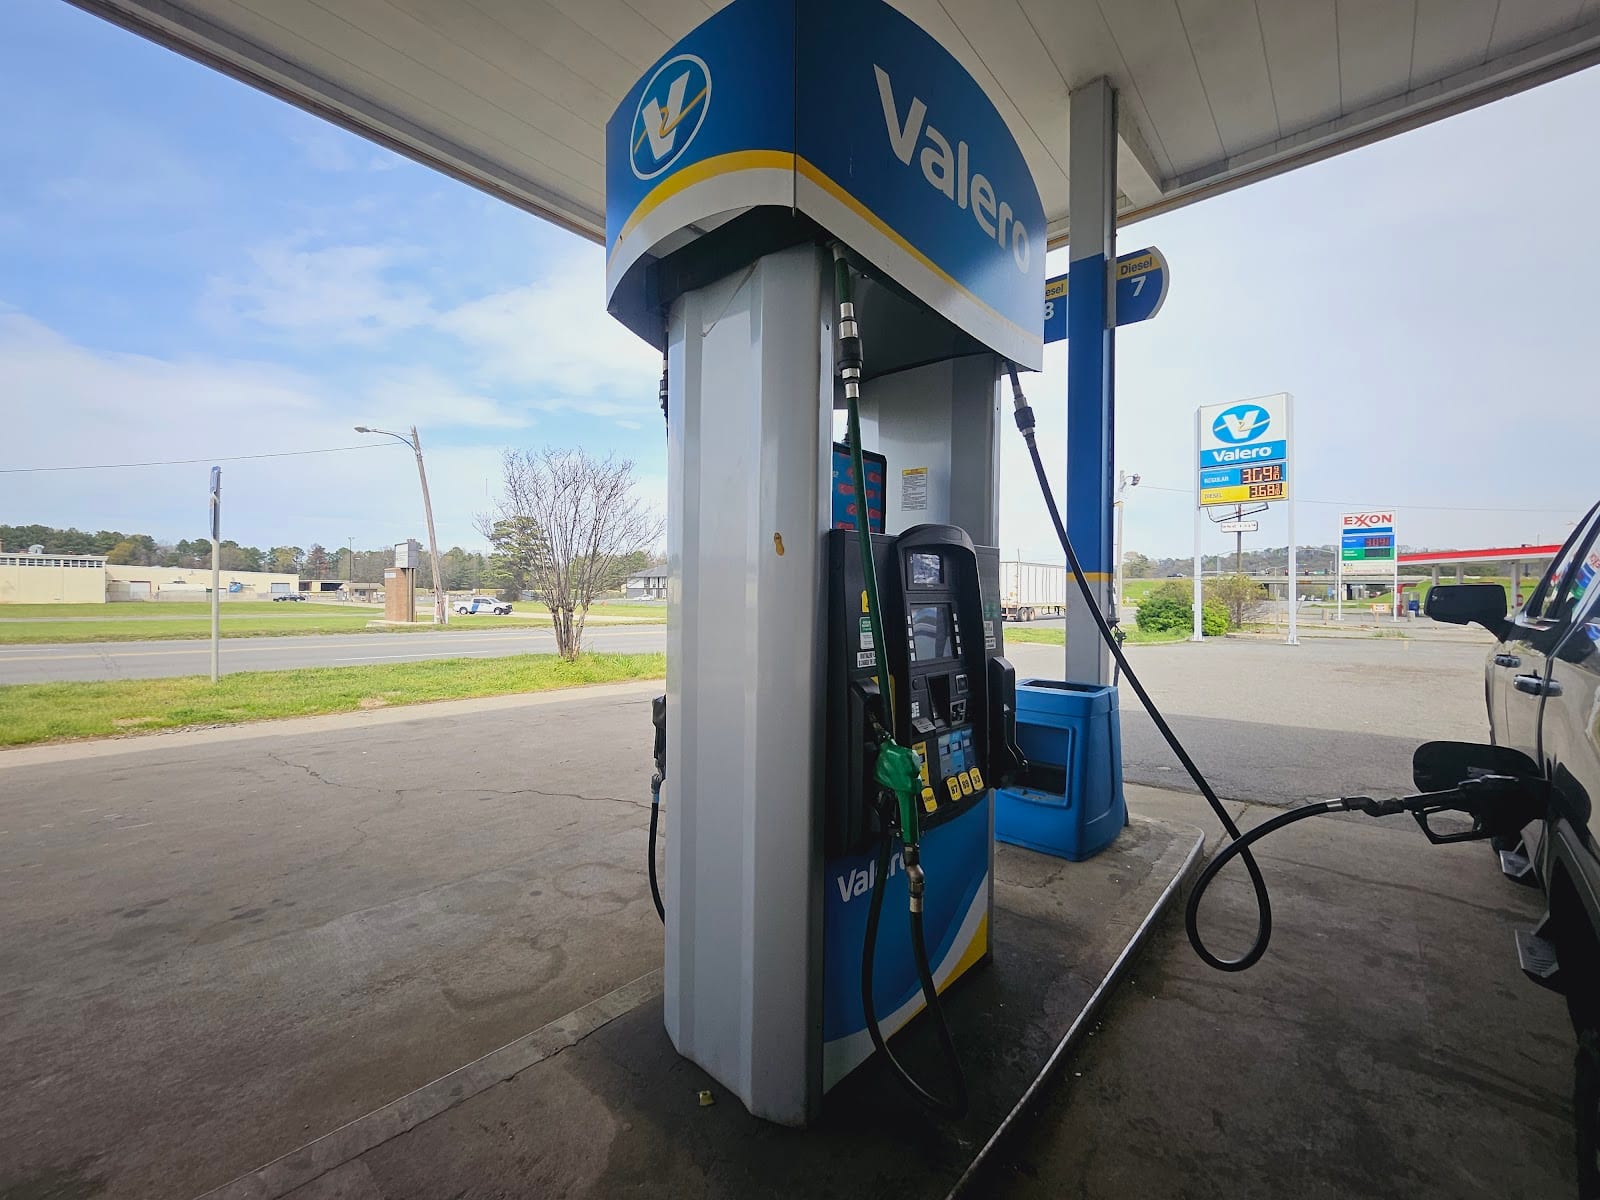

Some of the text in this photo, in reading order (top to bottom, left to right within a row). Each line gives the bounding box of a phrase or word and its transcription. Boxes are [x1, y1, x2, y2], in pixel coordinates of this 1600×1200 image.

[873, 63, 1030, 275] Valero
[1120, 257, 1153, 276] Diesel
[1045, 283, 1065, 297] esel
[1131, 275, 1147, 297] 7
[1212, 446, 1272, 462] Valero
[1343, 514, 1393, 527] EXXON
[837, 852, 906, 903] Valr
